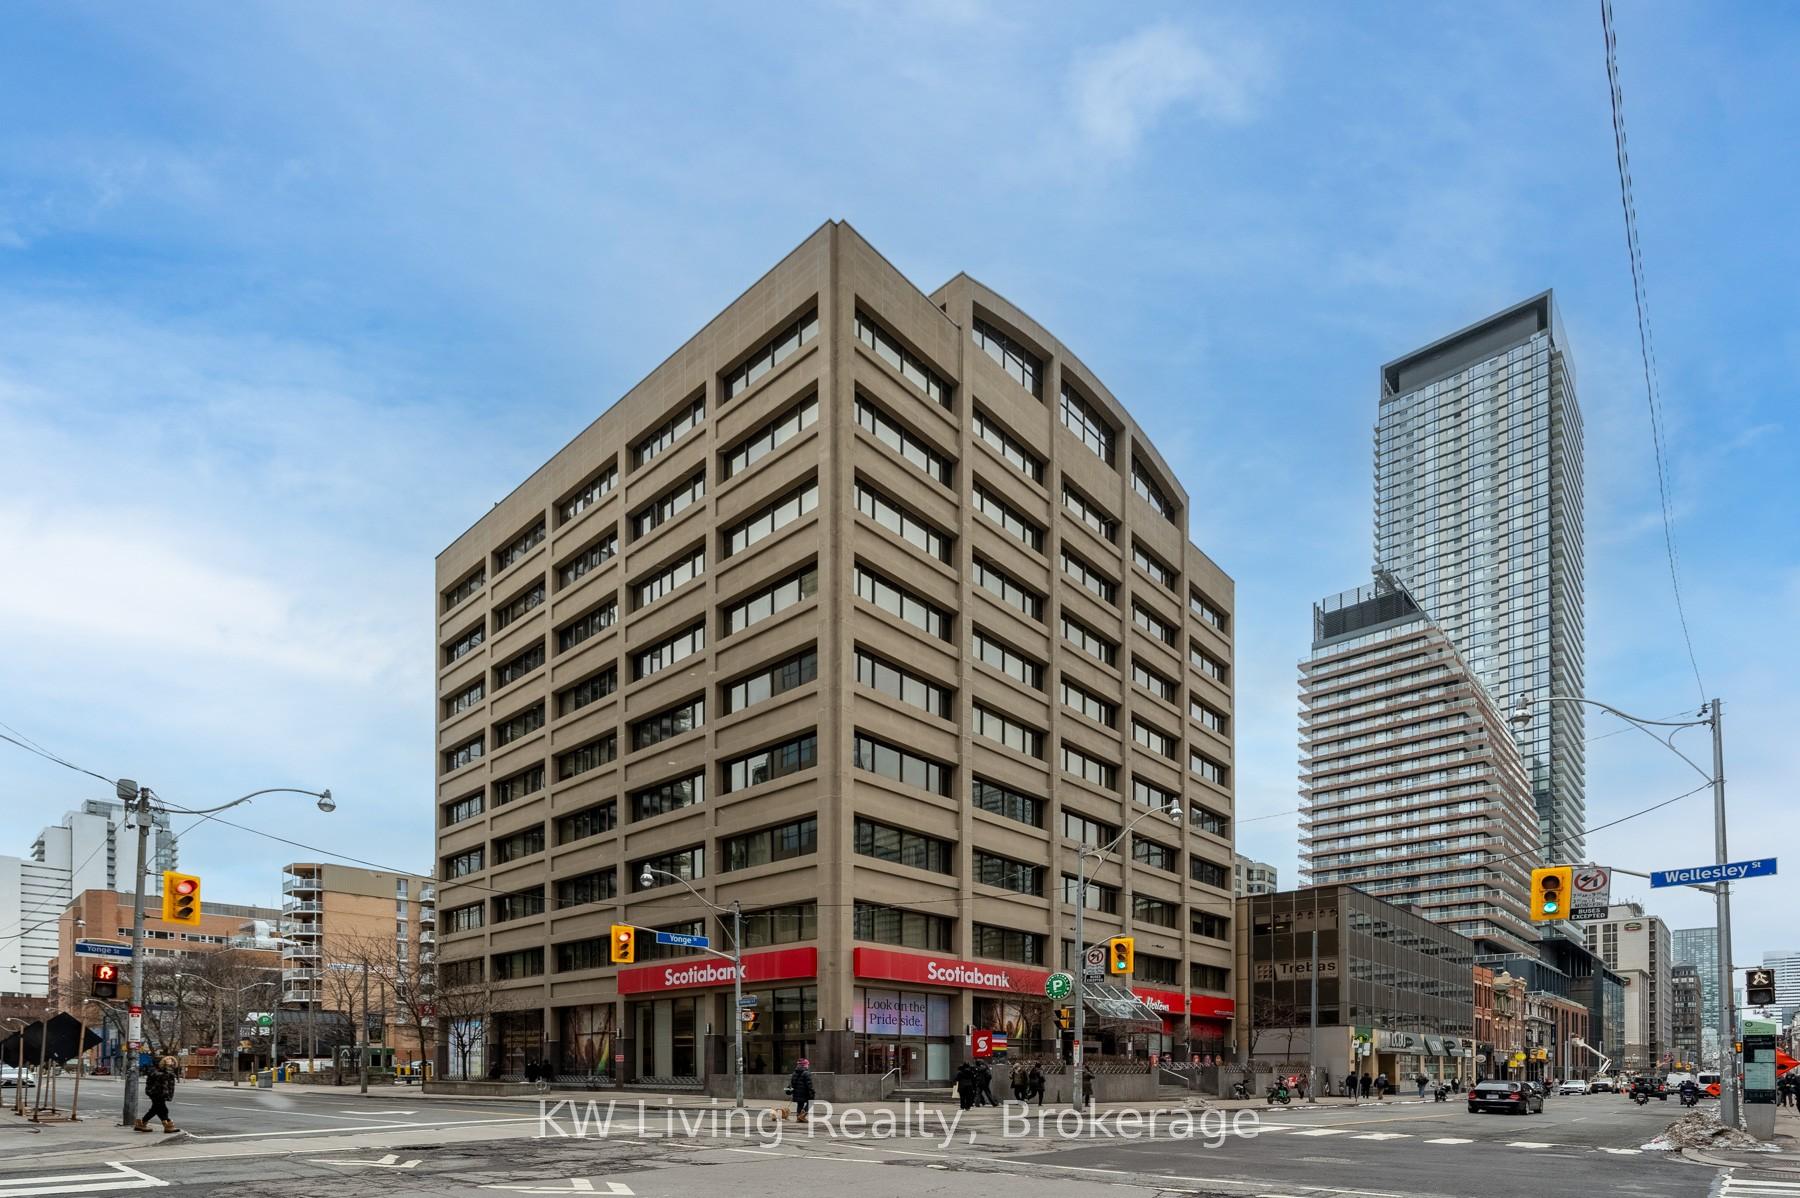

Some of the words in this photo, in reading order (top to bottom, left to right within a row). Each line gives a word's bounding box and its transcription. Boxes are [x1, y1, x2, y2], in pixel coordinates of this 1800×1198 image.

[1665, 864, 1748, 883] Wellesley
[669, 933, 692, 945] Yonge
[87, 945, 112, 954] Yonge
[1280, 961, 1336, 974] Trebas
[664, 964, 747, 986] Scotiabank
[927, 961, 1010, 989] Scotiabank
[1053, 979, 1063, 991] P
[867, 997, 892, 1010] Look
[893, 1002, 908, 1011] on
[909, 1001, 926, 1013] the
[870, 1013, 898, 1025] Pride
[900, 1015, 923, 1027] side.
